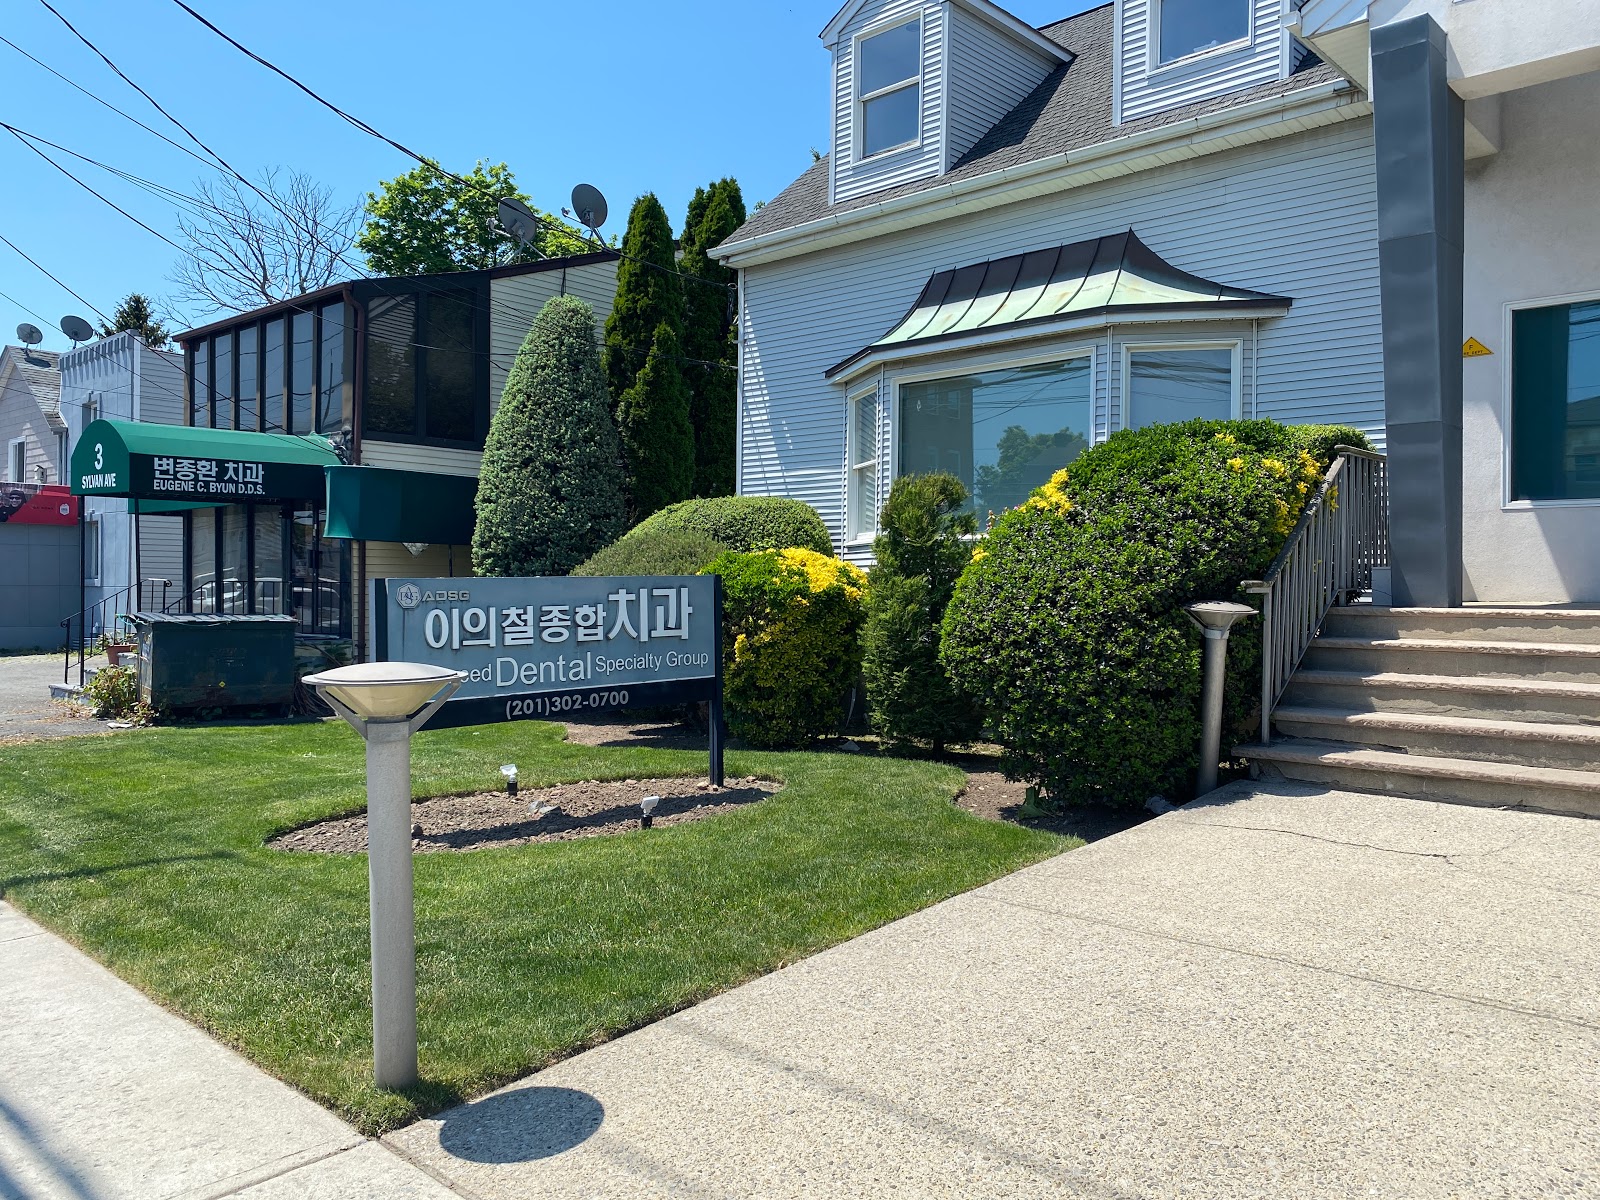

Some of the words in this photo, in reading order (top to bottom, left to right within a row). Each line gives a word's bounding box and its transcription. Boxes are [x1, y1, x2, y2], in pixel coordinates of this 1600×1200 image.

[94, 442, 103, 471] 3
[81, 474, 104, 490] SYLVAN
[104, 472, 117, 488] AVE
[153, 457, 219, 481] 변종환
[223, 461, 265, 484] 치과
[153, 479, 195, 492] EUGENE
[197, 481, 207, 493] C.
[209, 482, 236, 494] BYUN
[238, 483, 266, 495] D.D.S.
[421, 590, 470, 602] ADSG
[496, 651, 592, 687] Dental
[595, 654, 663, 676] Specialty
[666, 650, 709, 668] Group
[505, 690, 629, 720] (201)302-0700
